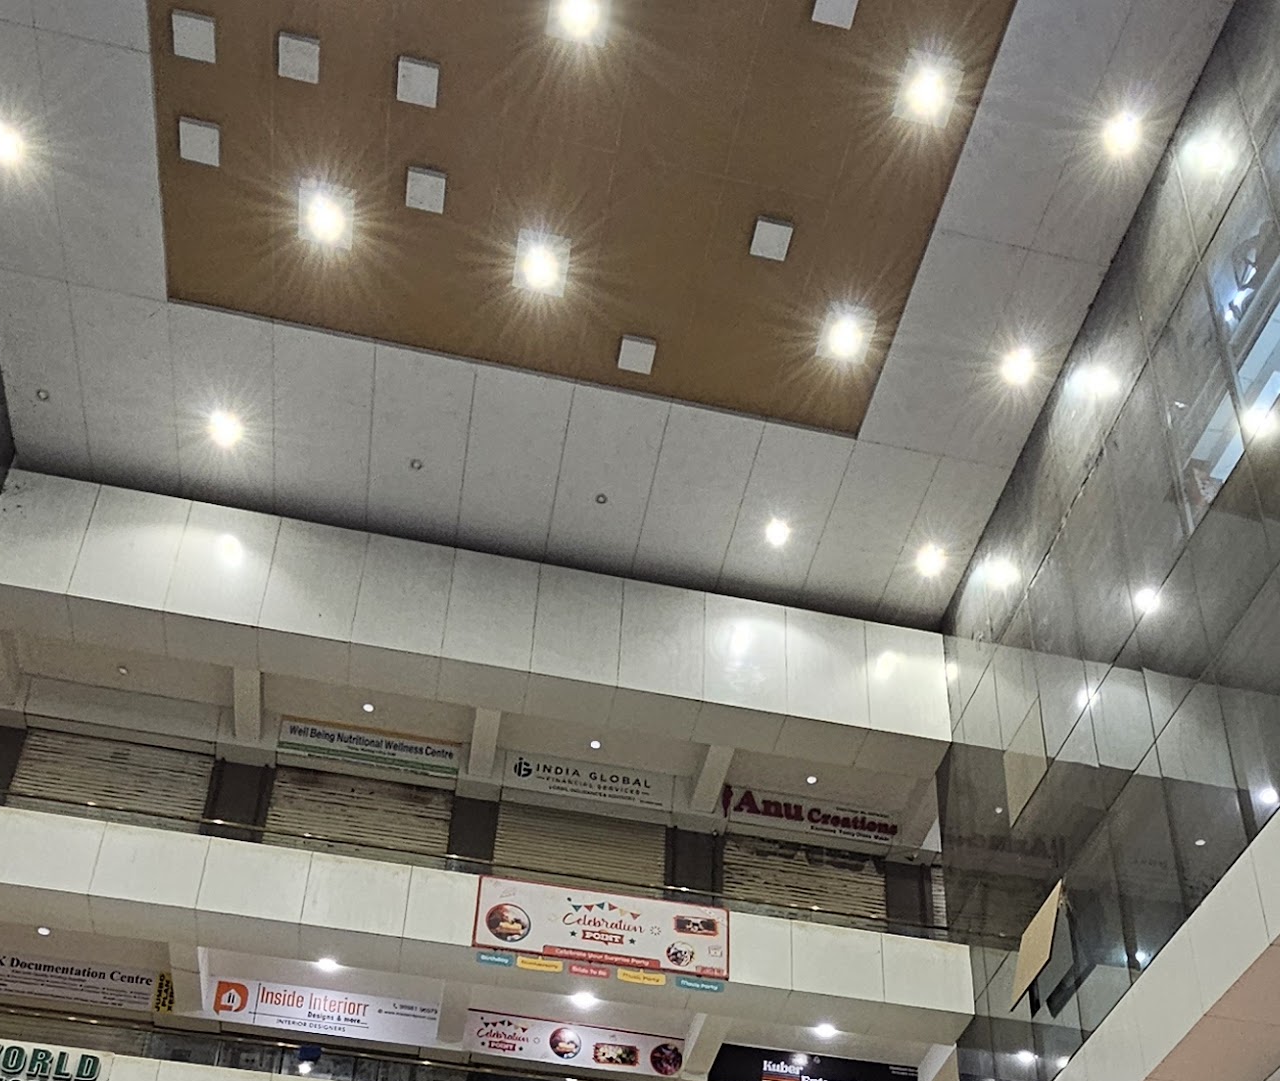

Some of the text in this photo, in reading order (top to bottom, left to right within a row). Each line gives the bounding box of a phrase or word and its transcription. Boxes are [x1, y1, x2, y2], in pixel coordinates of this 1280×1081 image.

[290, 725, 308, 736] Well
[310, 728, 335, 743] Being
[336, 733, 383, 748] Nutritional
[385, 742, 423, 755] Wellness
[425, 746, 454, 759] Centre
[536, 763, 651, 788] INDIA GLOBAL
[733, 790, 804, 821] Anu
[807, 808, 897, 836] Creations
[562, 912, 645, 934] Celebration
[10, 957, 106, 980] Documentation
[109, 970, 153, 986] Centre
[260, 987, 305, 1009] Inside
[308, 993, 369, 1017] Interiorr
[763, 1060, 803, 1075] Kuber
